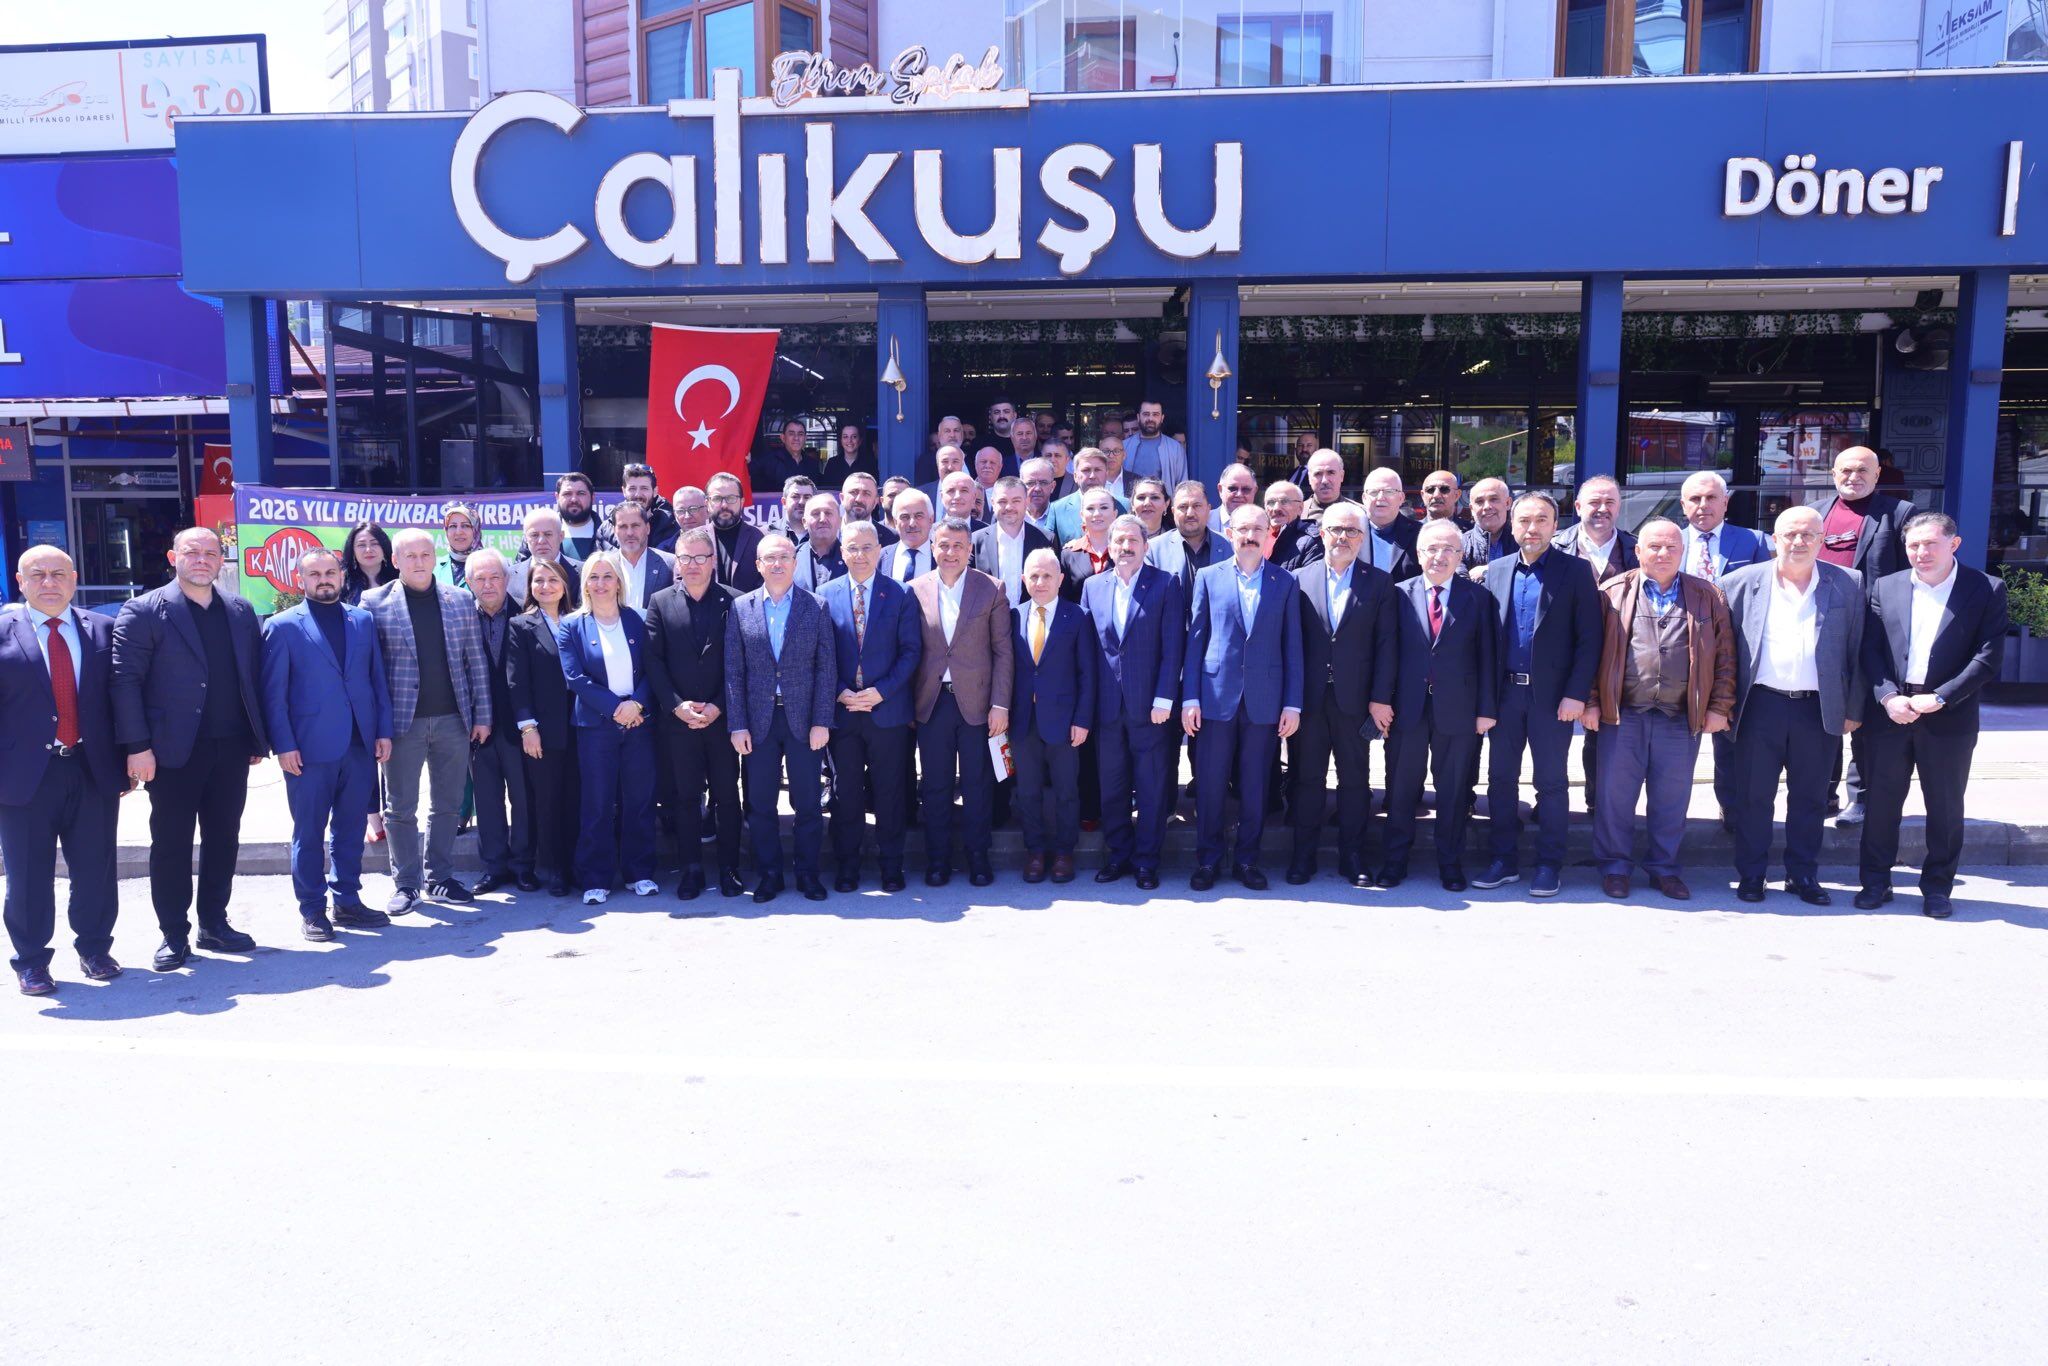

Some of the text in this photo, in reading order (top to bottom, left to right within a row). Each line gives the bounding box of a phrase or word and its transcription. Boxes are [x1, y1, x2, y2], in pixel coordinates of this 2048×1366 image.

[143, 47, 247, 68] SAYISAL
[772, 50, 886, 109] Ekrem
[29, 115, 71, 123] PİYANGO
[75, 112, 115, 122] İDARESİ
[1724, 153, 1943, 217] Döner
[249, 498, 298, 520] 2026
[302, 500, 341, 522] YILI
